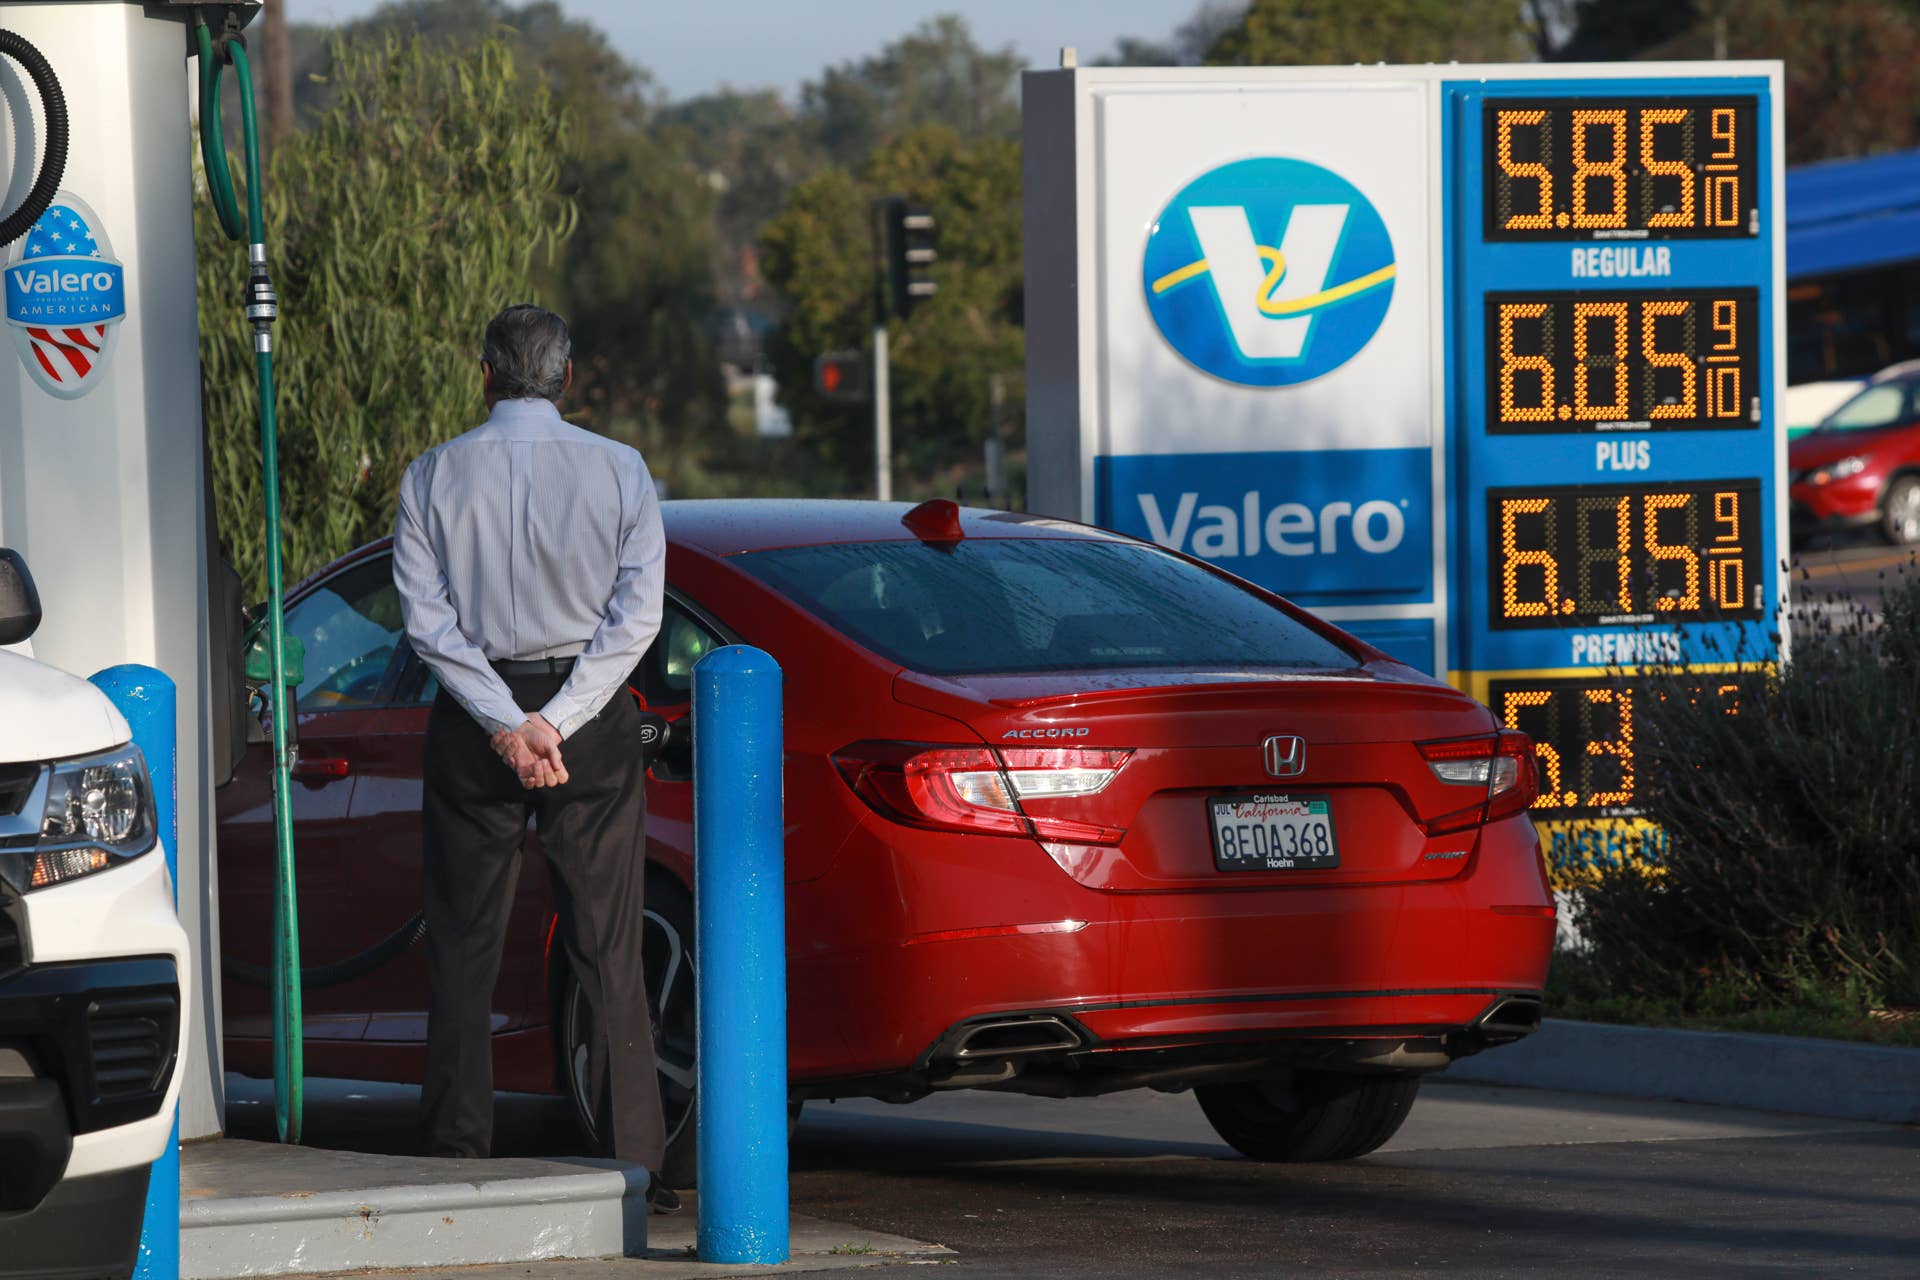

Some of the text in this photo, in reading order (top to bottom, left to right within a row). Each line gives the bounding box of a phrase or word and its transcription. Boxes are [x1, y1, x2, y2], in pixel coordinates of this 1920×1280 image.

[1498, 109, 1695, 229] 5.85
[1572, 246, 1671, 278] REGULAR
[14, 269, 113, 294] Valero
[20, 303, 112, 316] AMERICAN
[1500, 301, 1696, 422] 6.05
[1597, 440, 1651, 471] PLUS
[1137, 491, 1405, 558] Valero
[1502, 493, 1700, 618] 6.15
[1572, 631, 1680, 665] PREMIUM
[1002, 727, 1090, 739] ACCORD
[1216, 805, 1231, 816] JUL
[1235, 803, 1302, 822] California
[1253, 794, 1289, 803] Carlsbad
[1267, 858, 1294, 868] Hoehn
